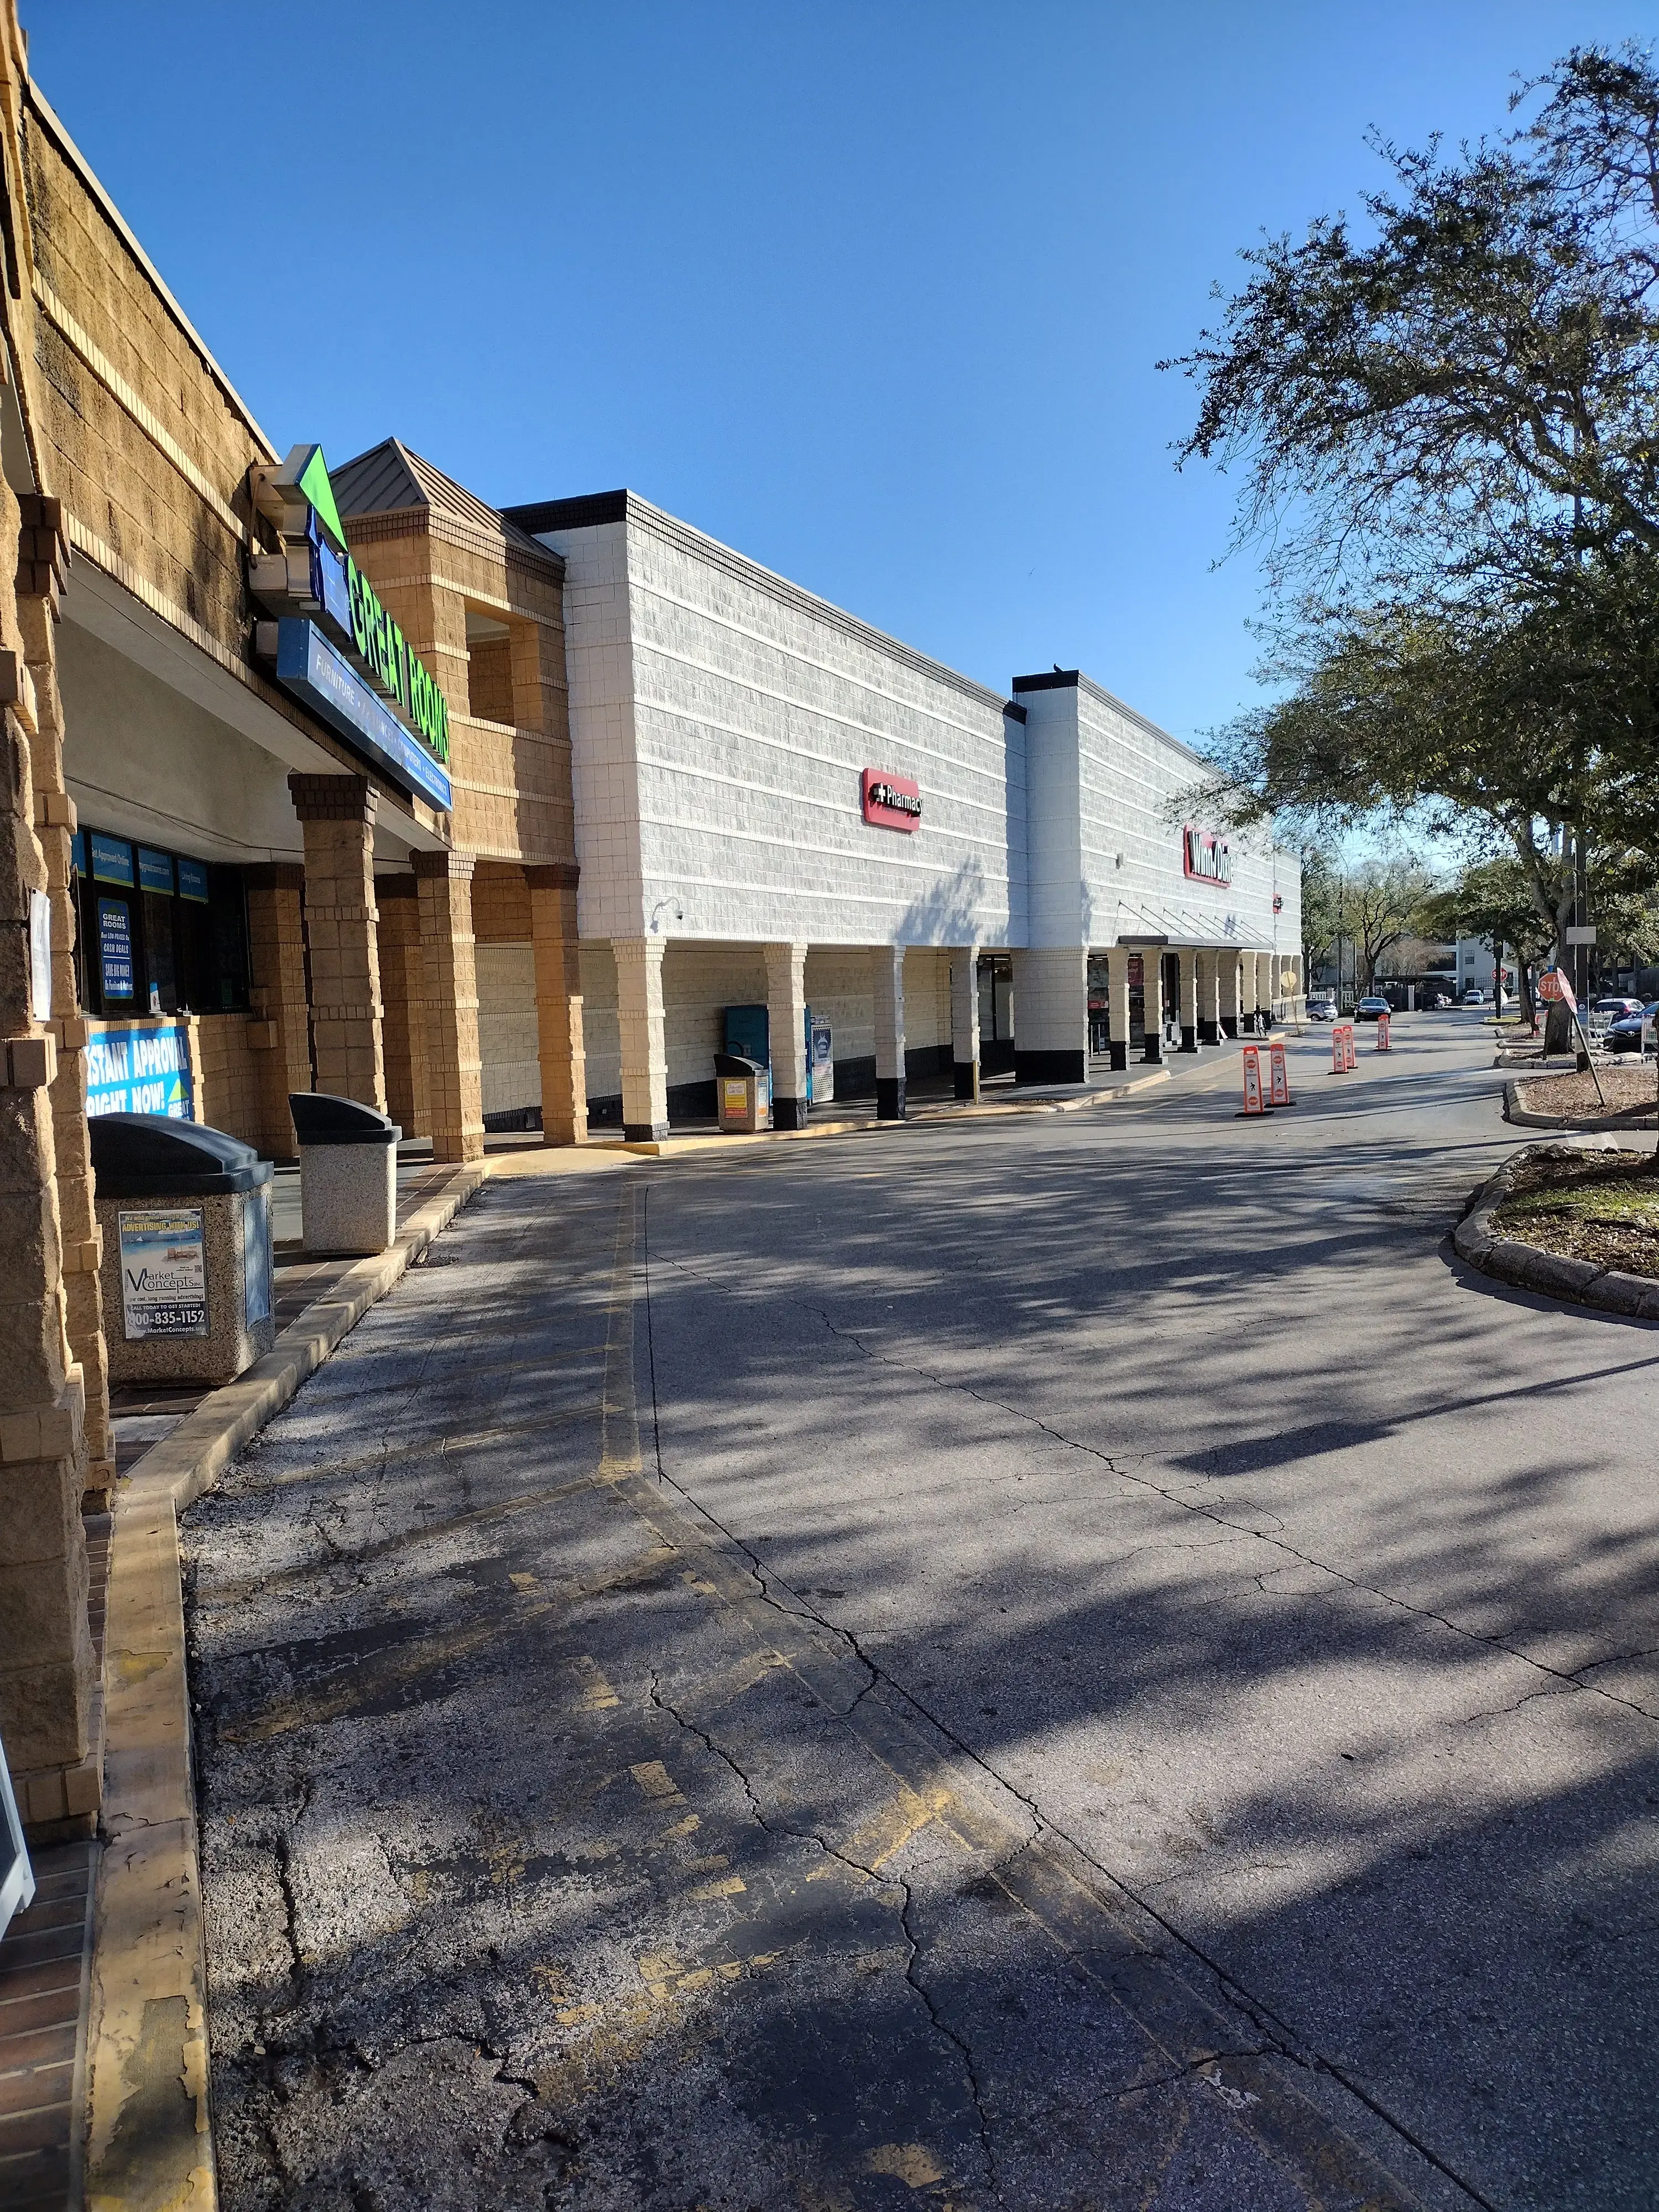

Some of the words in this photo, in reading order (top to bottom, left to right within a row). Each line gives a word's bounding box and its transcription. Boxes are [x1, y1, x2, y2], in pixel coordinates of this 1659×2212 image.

[347, 555, 406, 708] GREAT
[408, 644, 449, 765] ROOMS
[316, 654, 356, 706] FURNITURE
[398, 737, 422, 772] COMPUTERS
[425, 766, 448, 797] ELECTRONICS
[887, 784, 924, 817] Pharmacy
[1192, 830, 1213, 878] Winn
[1217, 841, 1234, 883] Dixie
[103, 914, 126, 922] GREAT
[103, 920, 126, 929] ROOMS
[103, 943, 115, 953] CASH
[116, 944, 129, 954] DEALS
[133, 1036, 188, 1078] APPROVAL
[132, 1081, 165, 1113] NOW!
[168, 1100, 189, 1118] GREAT
[122, 1222, 166, 1232] ADVERTISING
[169, 1222, 185, 1230] WITH
[127, 1267, 174, 1292] Market
[142, 1276, 194, 1293] Concepts
